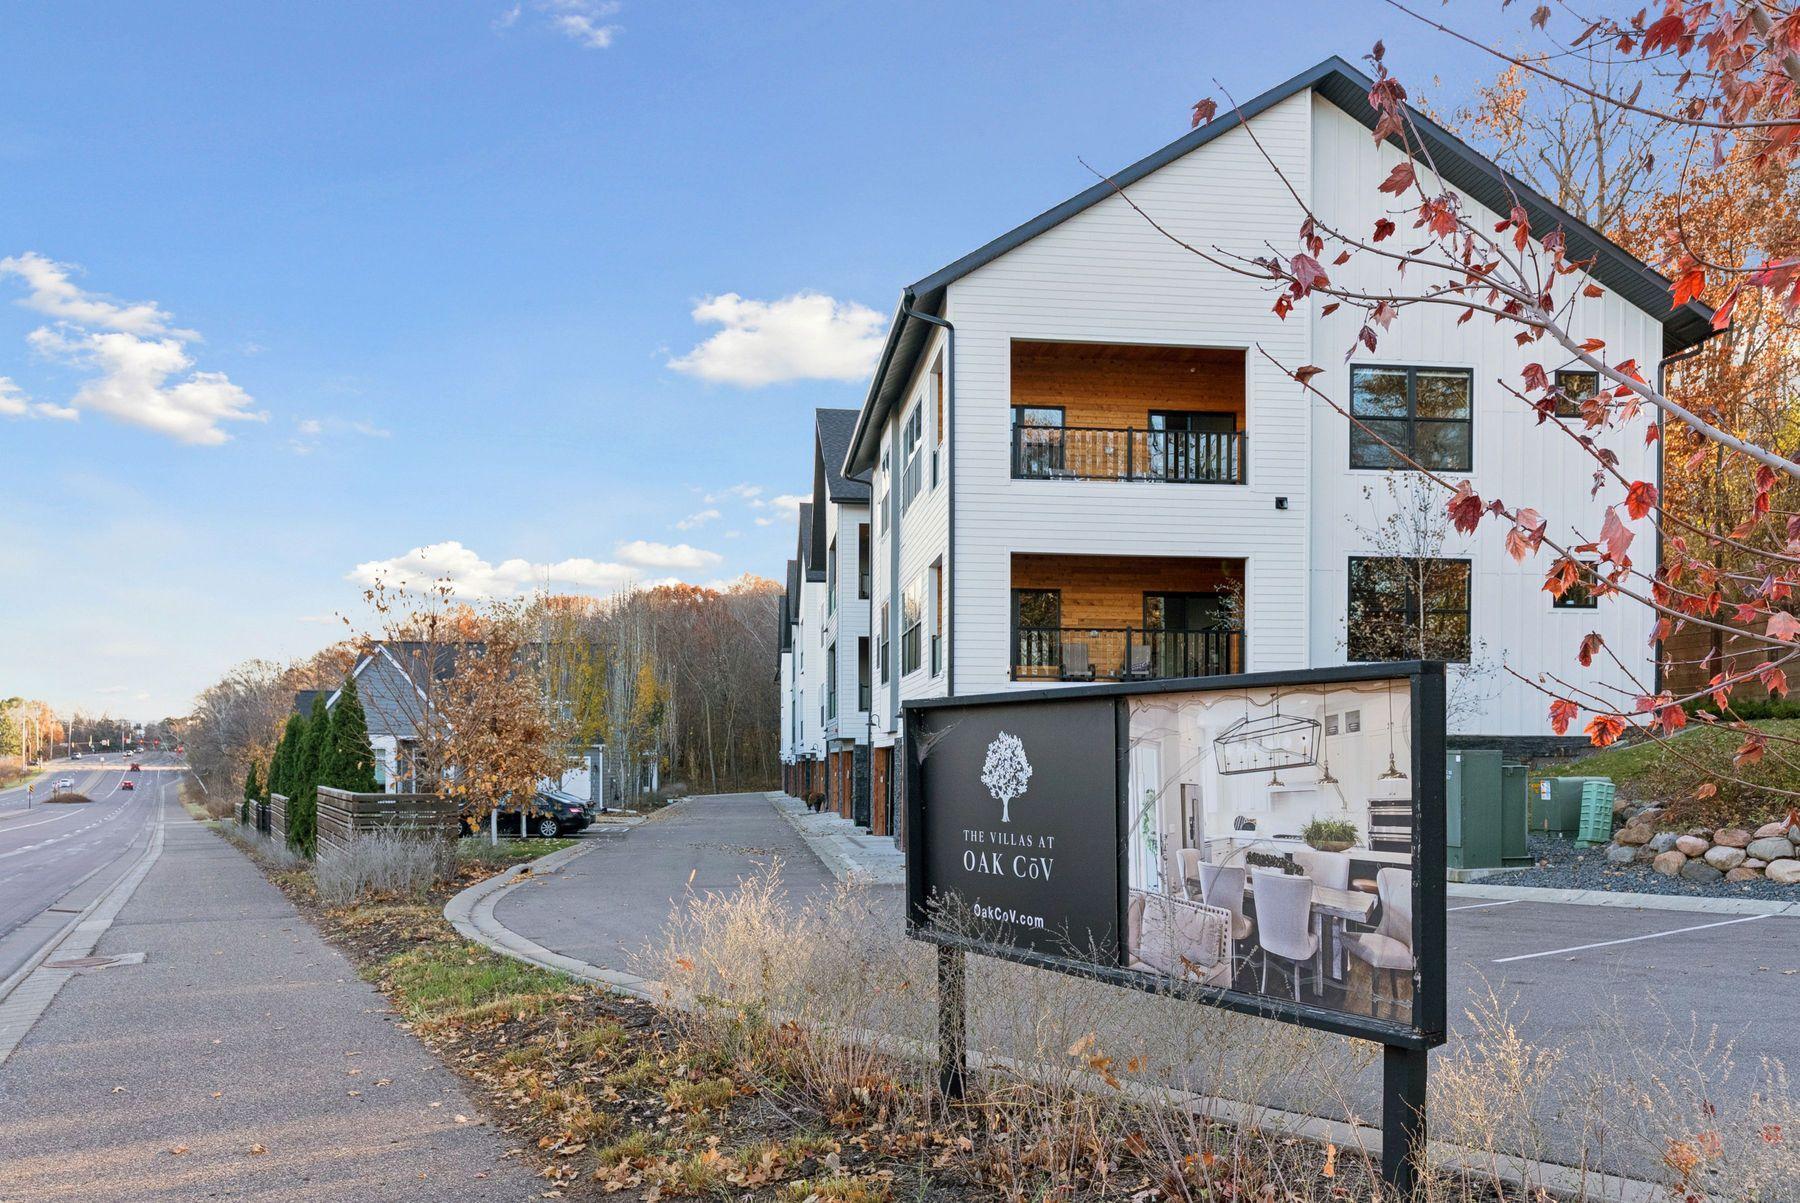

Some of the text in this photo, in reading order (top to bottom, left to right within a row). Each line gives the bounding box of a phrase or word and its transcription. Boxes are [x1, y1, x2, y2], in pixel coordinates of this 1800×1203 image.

[963, 829, 1055, 849] THE VILLAS AT
[963, 850, 1054, 881] OAK CōV
[973, 903, 1044, 928] OakCoV.com
